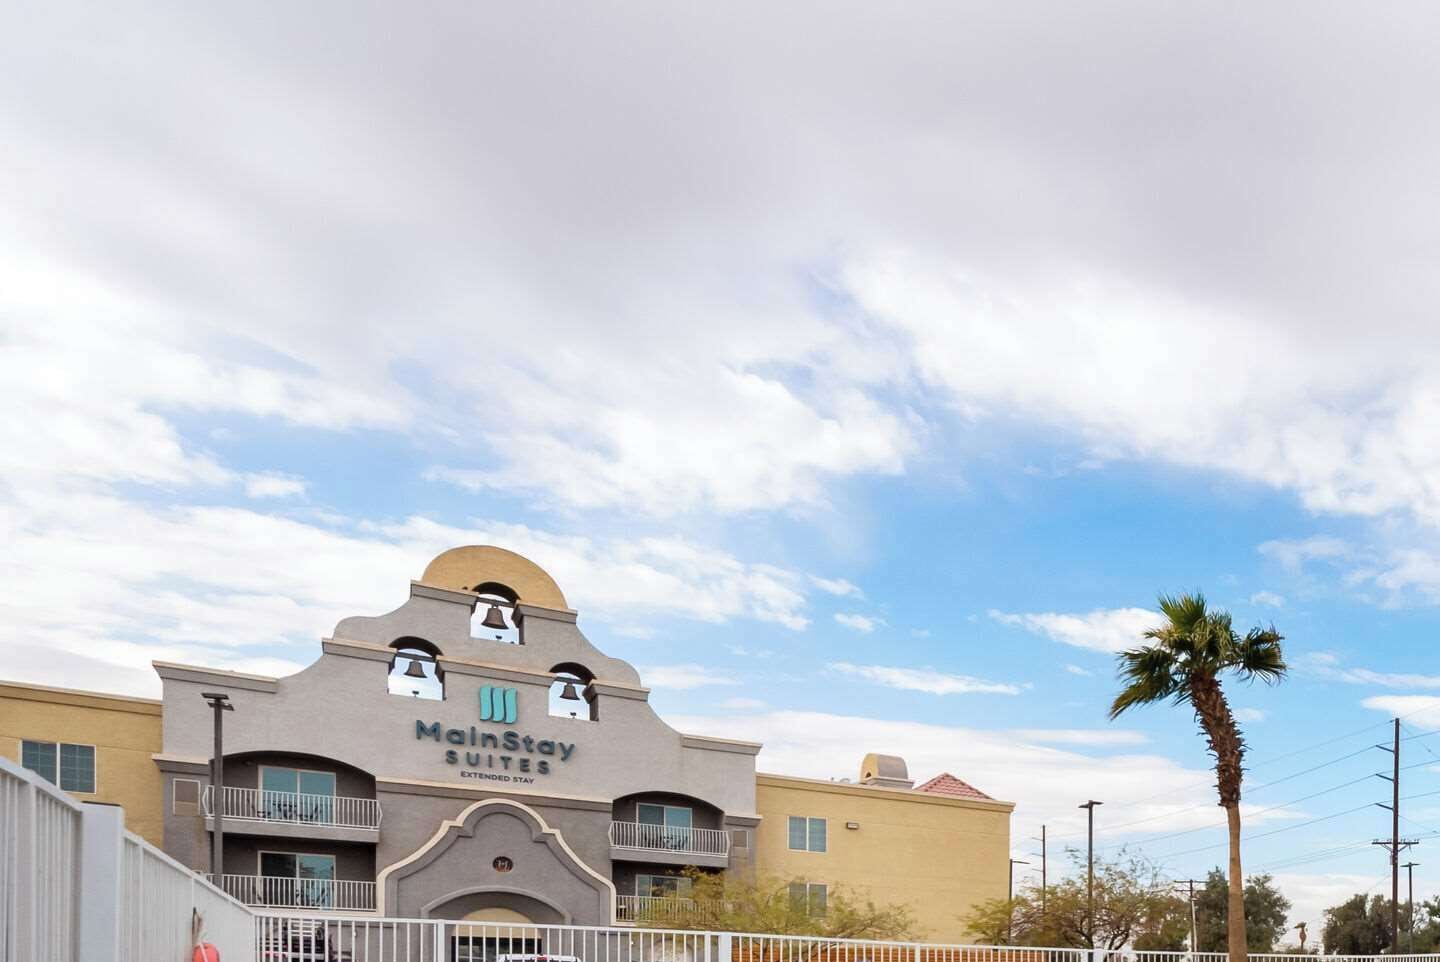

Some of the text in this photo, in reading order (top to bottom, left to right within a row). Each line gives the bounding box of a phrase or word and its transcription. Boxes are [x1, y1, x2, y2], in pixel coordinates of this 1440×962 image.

[416, 720, 575, 761] MainStay
[446, 750, 550, 775] SUITES
[460, 771, 535, 784] EXTENDED STAY
